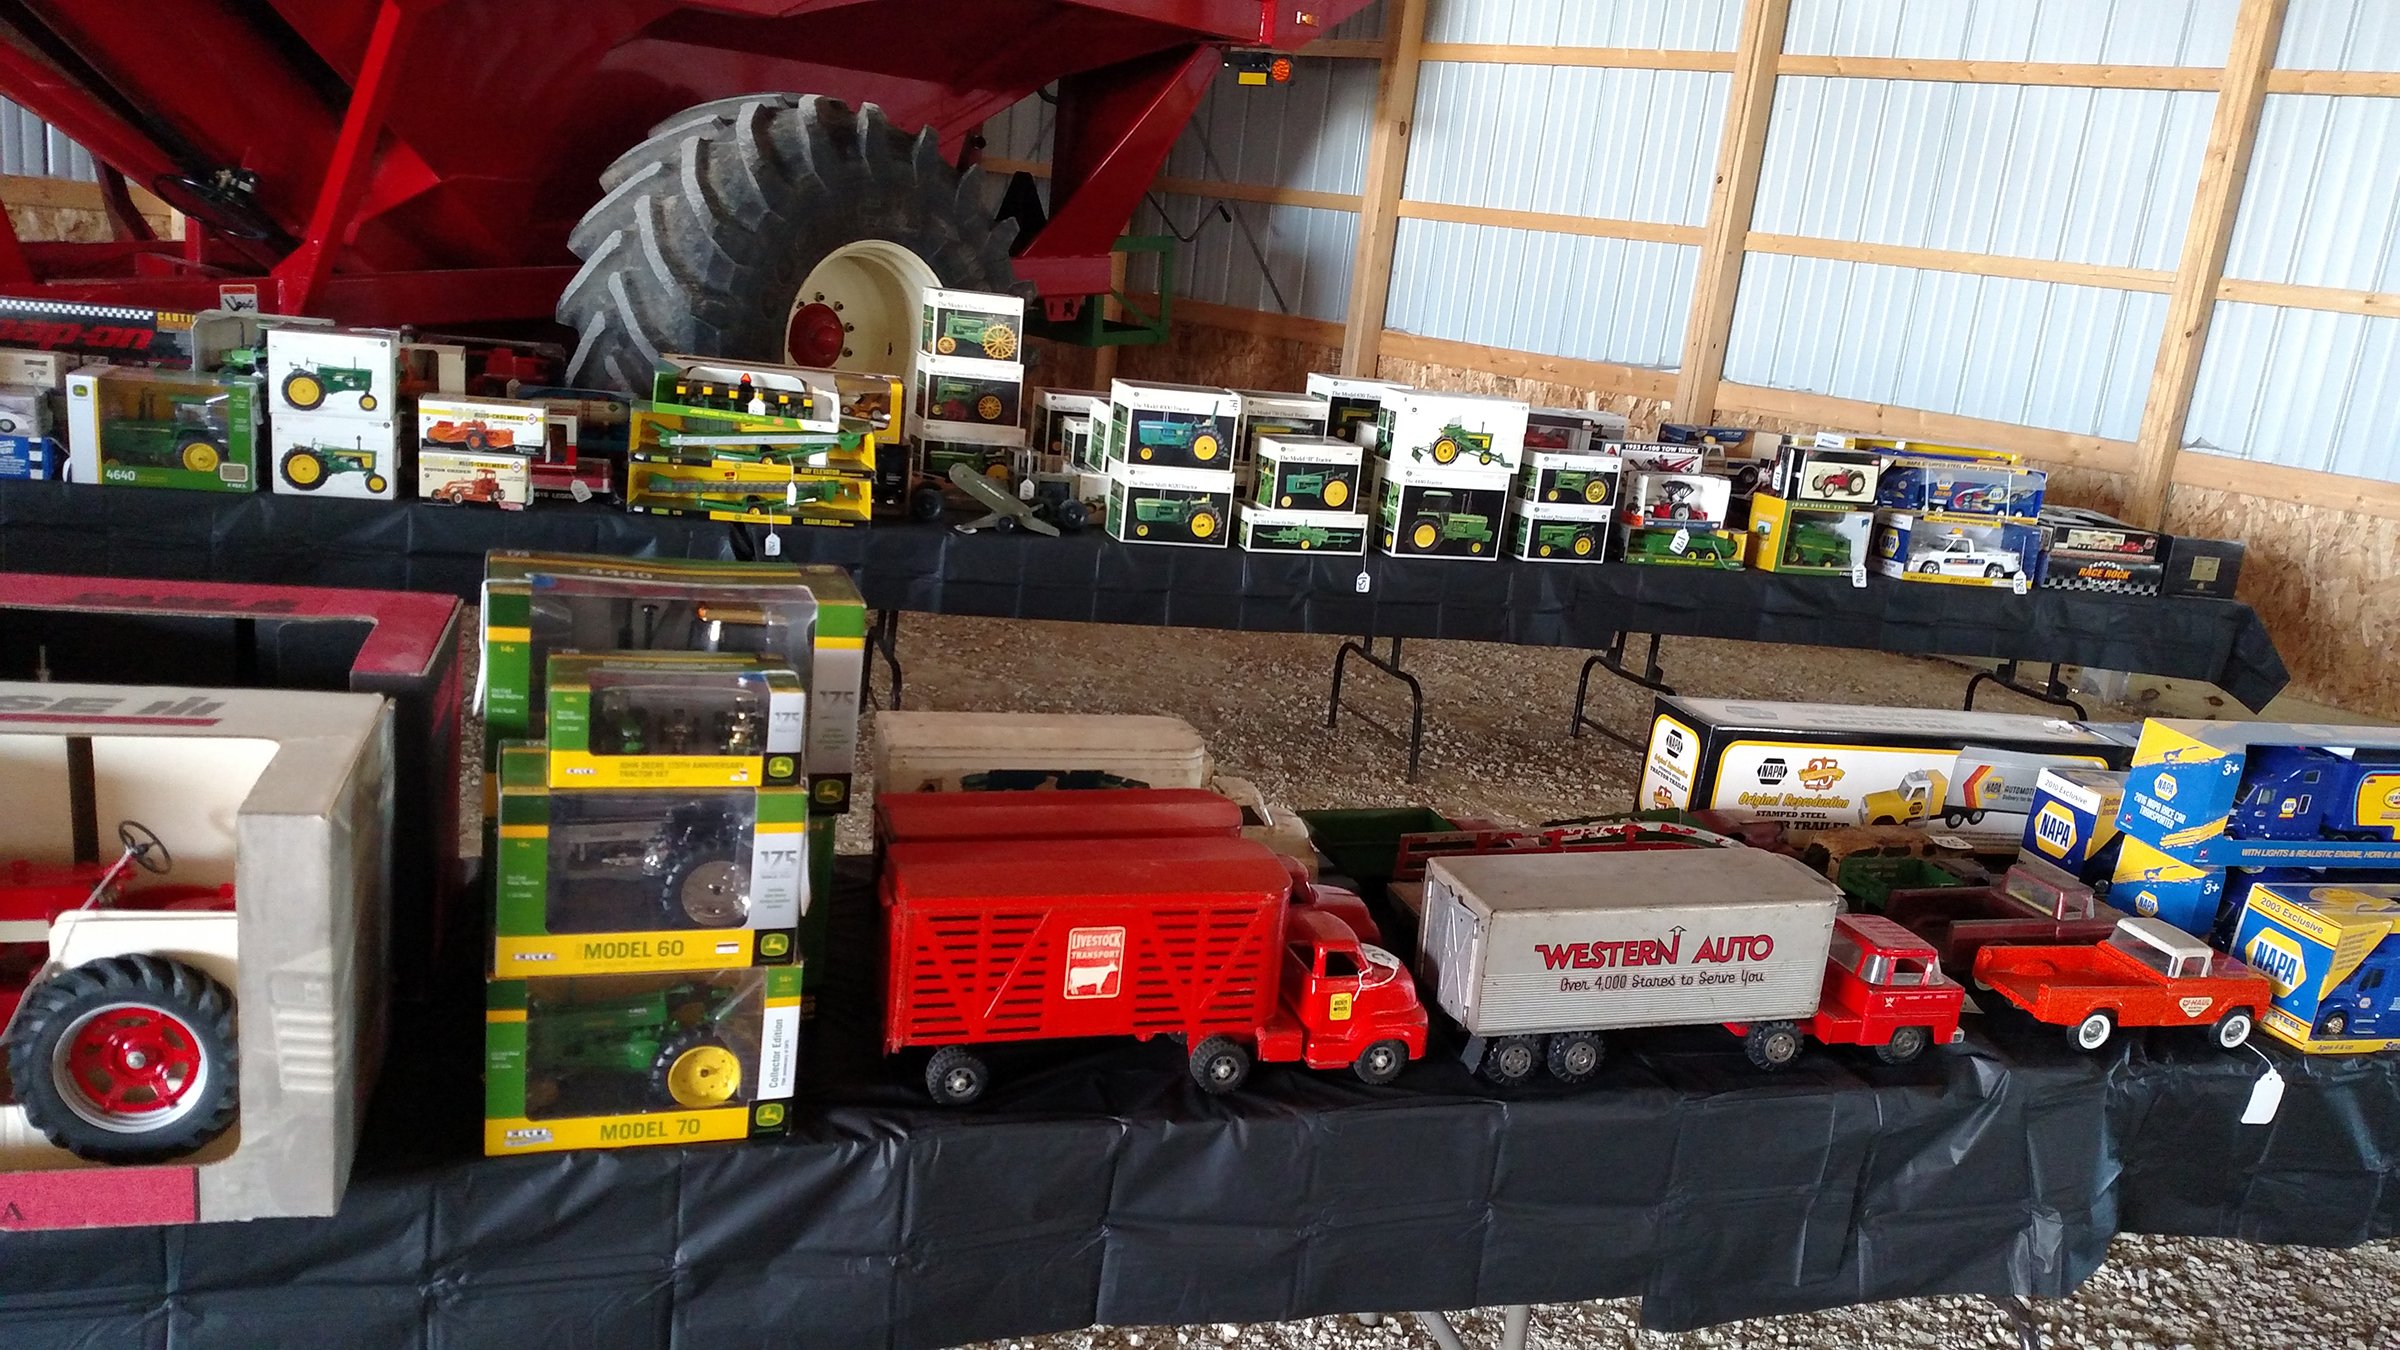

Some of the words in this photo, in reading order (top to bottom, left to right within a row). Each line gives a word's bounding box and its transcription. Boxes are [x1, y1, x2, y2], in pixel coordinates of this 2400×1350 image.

[0, 318, 155, 351] ap-on
[106, 469, 136, 481] 4640
[1883, 533, 1898, 550] NAPA
[588, 568, 653, 579] 4440
[2078, 567, 2103, 578] RACE
[2103, 569, 2131, 580] ROCK
[820, 690, 854, 705] 175
[774, 711, 800, 722] 175
[1667, 735, 1682, 754] NAPA
[1649, 765, 1670, 784] TRACTOR
[1669, 775, 1688, 793] TRAILER
[1761, 764, 1784, 778] NAPA
[2222, 763, 2240, 776] 3+
[1985, 781, 2002, 793] NAPA
[2003, 784, 2035, 796] AUTOMOTI
[2044, 778, 2060, 791] 2010
[2059, 784, 2089, 806] Exclusive
[2157, 778, 2175, 795] NAPA
[1738, 791, 1783, 809] Original
[1782, 792, 1850, 810] Reproduction
[1755, 810, 1798, 818] STAMPED
[1800, 811, 1828, 819] STEEL
[2139, 804, 2176, 830] TRANSPORTER
[2160, 801, 2176, 819] RACE
[2174, 809, 2187, 825] CAR
[2039, 812, 2071, 848] NAPA
[760, 850, 797, 866] 175
[2241, 848, 2261, 857] WITH
[2261, 848, 2289, 858] LIGHTS
[2295, 849, 2334, 859] REALISTIC
[2364, 851, 2387, 860] HORN
[2203, 882, 2220, 895] 3+
[2138, 895, 2156, 912] NAPA
[2260, 896, 2282, 914] 2003
[2281, 907, 2324, 935] Exclusive
[583, 941, 652, 960] MODEL
[657, 939, 685, 957] 60
[1071, 931, 1123, 950] LIVESTOCK
[1070, 949, 1121, 960] TRANSPORT
[1534, 932, 1682, 971] WESTERN
[1691, 934, 1775, 965] AUTO
[2252, 940, 2298, 986] NAPA
[1560, 977, 1590, 992] Over
[1594, 975, 1627, 990] 4,000
[1681, 973, 1694, 986] to
[1698, 971, 1736, 985] Serve
[1740, 969, 1766, 986] You
[2271, 1010, 2302, 1032] STEEL
[771, 1018, 784, 1049] Edition
[768, 1051, 781, 1089] Collector
[599, 1120, 669, 1141] MODEL
[676, 1118, 701, 1135] 70
